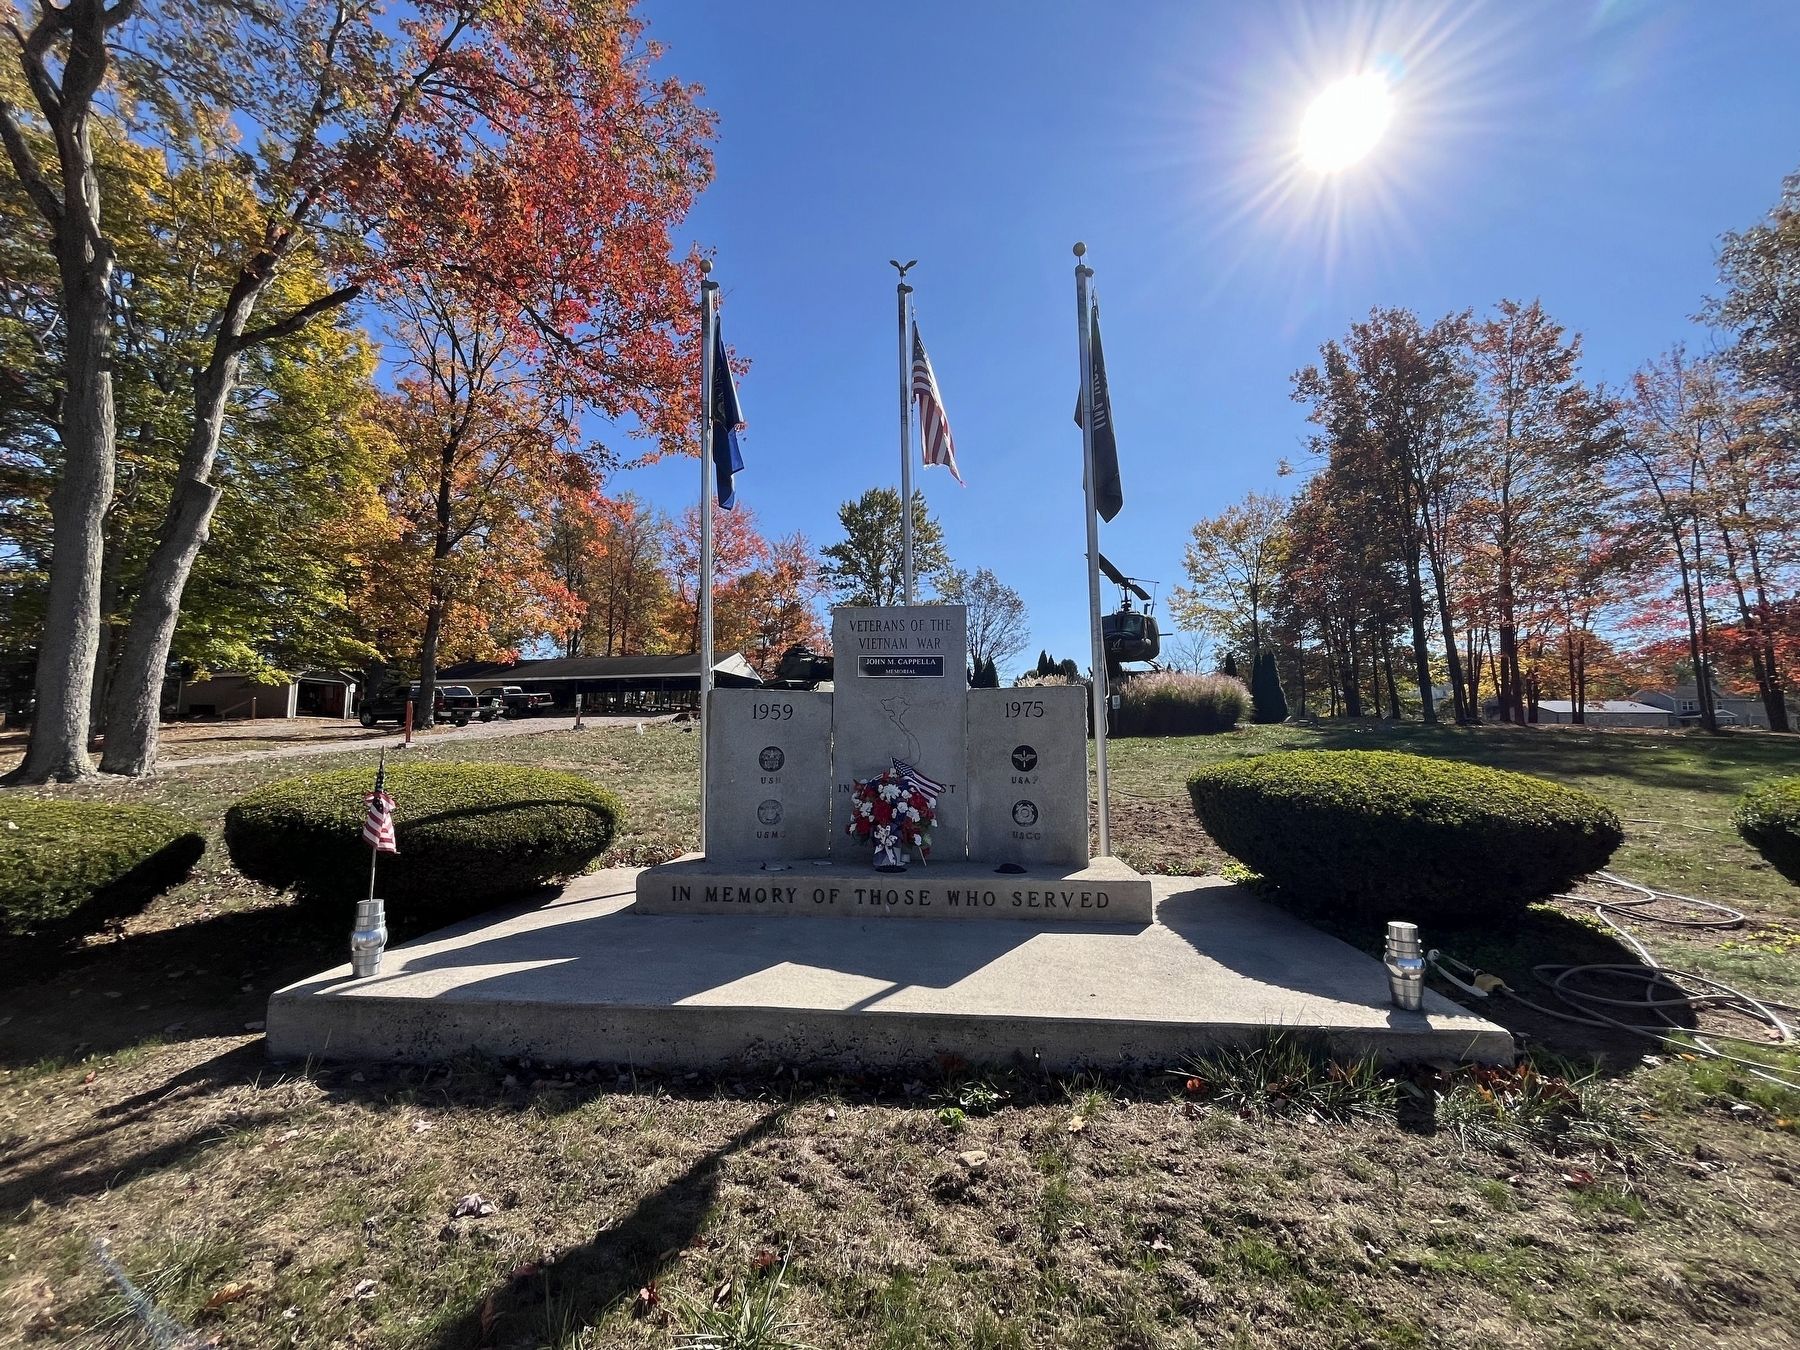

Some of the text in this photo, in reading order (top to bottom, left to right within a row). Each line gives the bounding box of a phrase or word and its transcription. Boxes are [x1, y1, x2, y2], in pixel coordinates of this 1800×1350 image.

[849, 620, 952, 632] VETERANS OF THE
[858, 637, 941, 650] VIETNAM WAR
[897, 658, 936, 666] CAPPELLA
[752, 703, 794, 721] 1959
[1005, 701, 1044, 718] 1975
[672, 886, 1110, 909] IN MEMORY OF THOSE WHO SERVED
